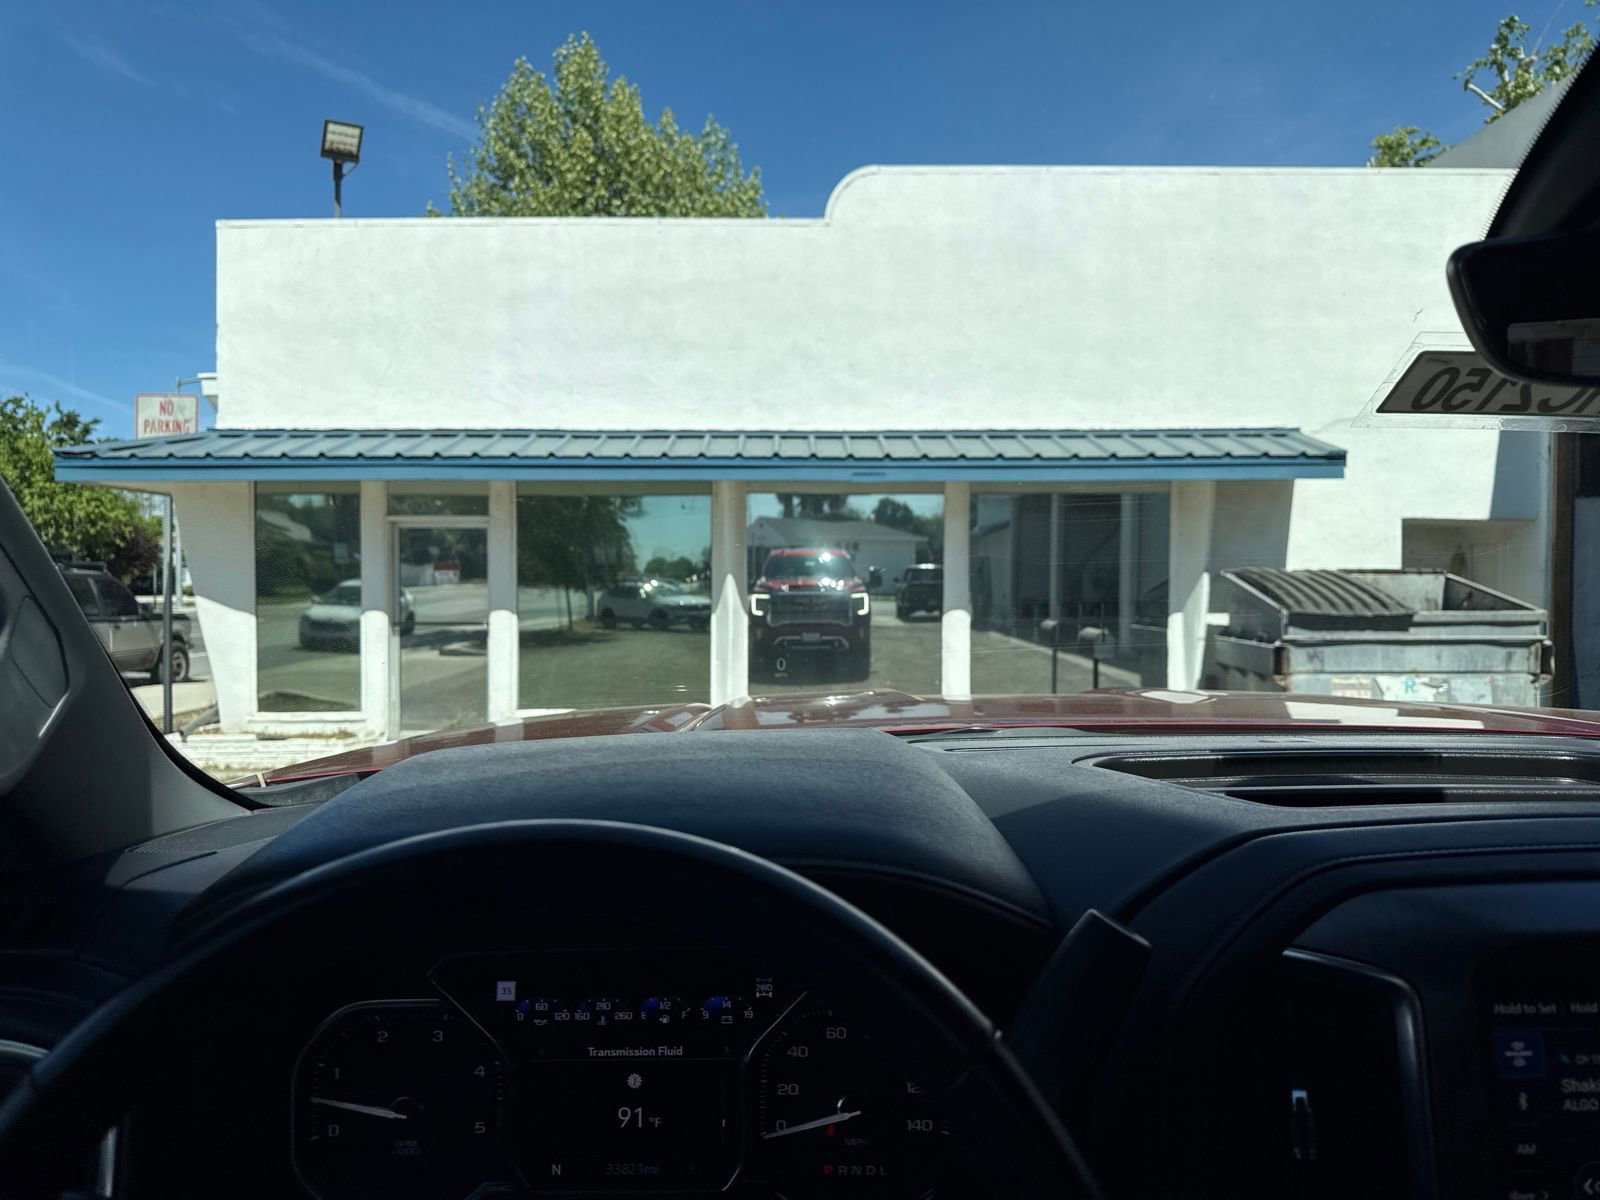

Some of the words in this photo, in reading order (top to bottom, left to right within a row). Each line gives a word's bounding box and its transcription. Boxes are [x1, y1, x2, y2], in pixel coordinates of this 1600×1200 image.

[159, 399, 175, 416] NO
[144, 419, 191, 434] PARKING
[776, 657, 787, 671] 0
[501, 986, 512, 996] 35
[535, 1002, 549, 1011] 60
[721, 1000, 731, 1009] 14
[554, 1012, 570, 1021] 120
[614, 1012, 633, 1020] 260
[640, 1011, 647, 1020] E
[681, 1010, 688, 1020] F
[702, 1011, 710, 1019] 9
[744, 1010, 754, 1019] 19
[377, 1030, 389, 1043] 2
[432, 1029, 444, 1043] 3
[825, 1027, 848, 1040] 60
[586, 1046, 656, 1057] Transmission
[658, 1045, 683, 1057] Fluid
[787, 1045, 809, 1058] 40
[333, 1067, 340, 1080] 1
[473, 1065, 486, 1078] 4
[776, 1083, 800, 1096] 20
[617, 1106, 644, 1128] 91
[327, 1124, 340, 1137] 0
[473, 1121, 487, 1135] 5
[775, 1119, 788, 1133] 0
[906, 1119, 934, 1132] 140
[551, 1163, 562, 1176] N
